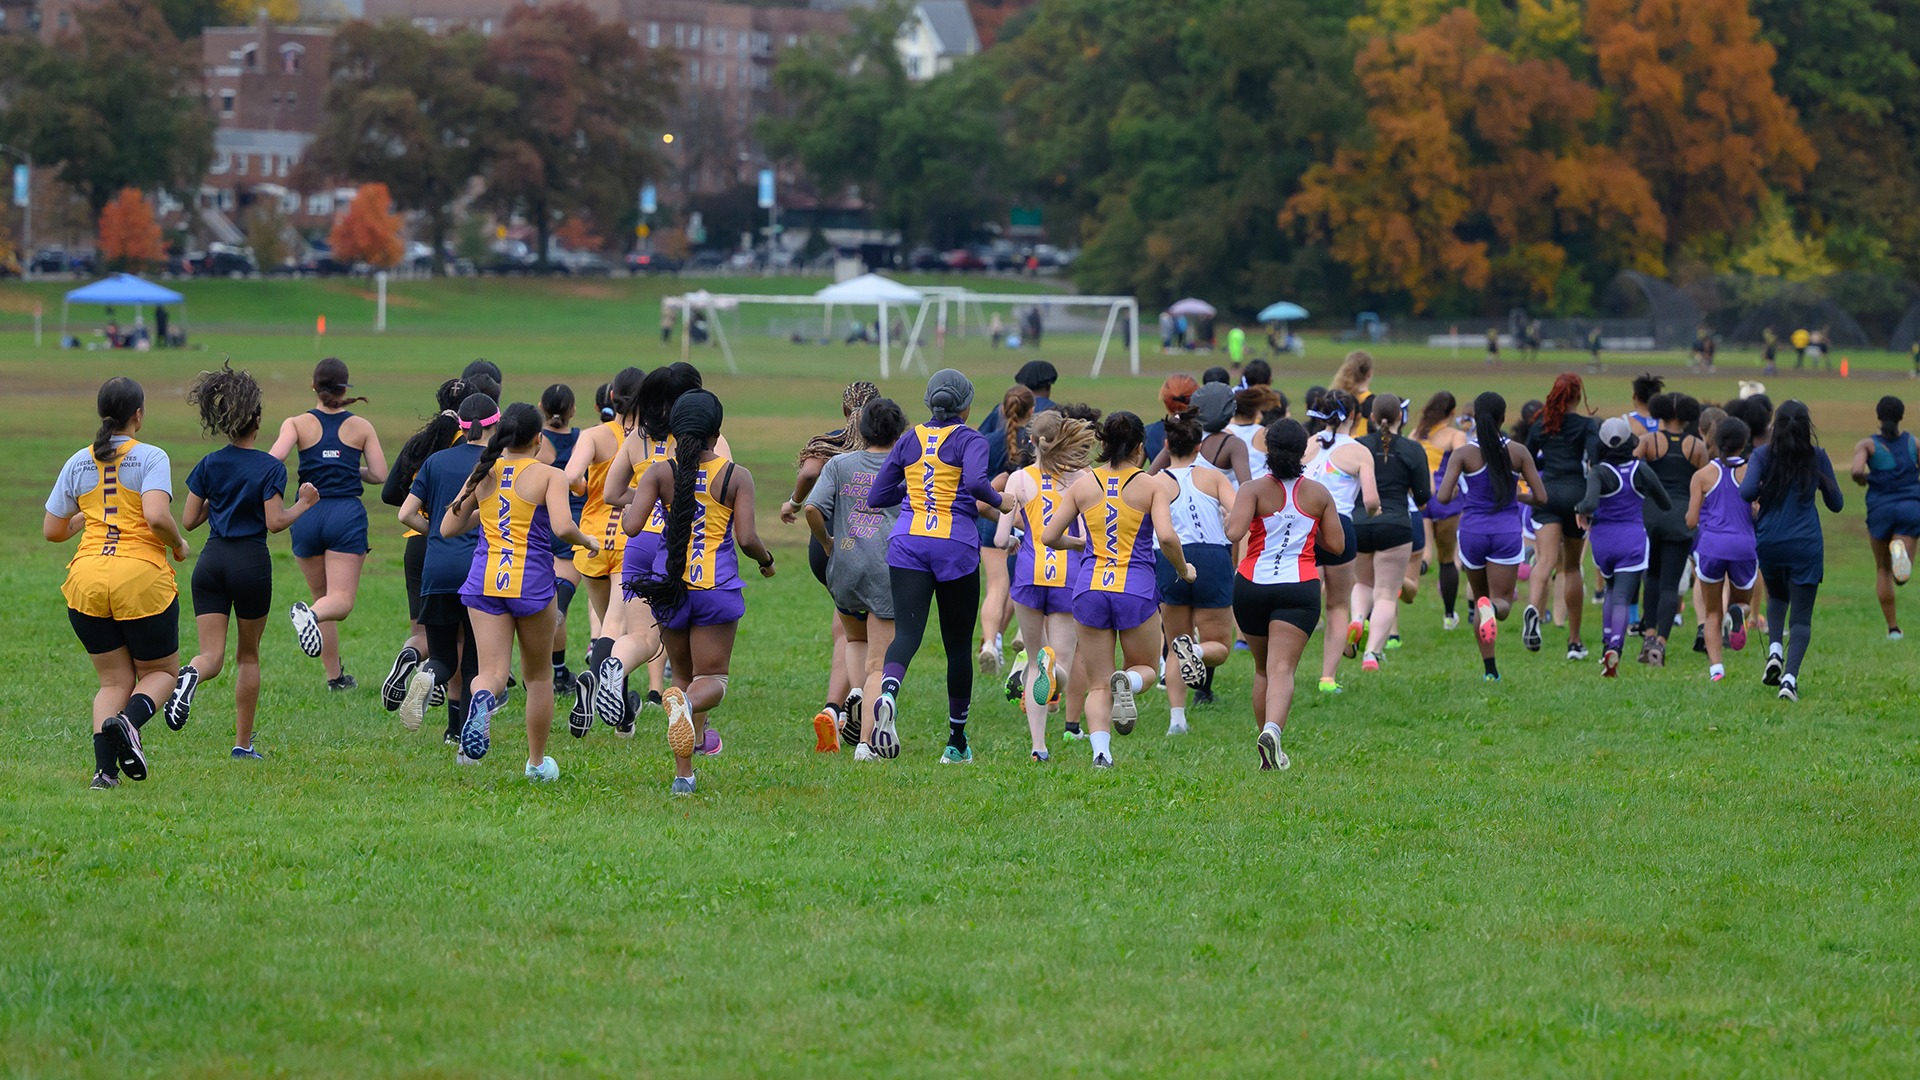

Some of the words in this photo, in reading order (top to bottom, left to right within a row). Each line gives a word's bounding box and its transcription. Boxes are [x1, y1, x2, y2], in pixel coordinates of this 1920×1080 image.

[840, 484, 872, 498] ARO
[851, 471, 877, 485] HA
[923, 433, 939, 532] HAWKS
[495, 465, 515, 592] HAWKS
[689, 469, 708, 585] HAWKS
[847, 512, 884, 525] FIND
[848, 526, 879, 538] OUT
[1102, 476, 1119, 588] HAWKS
[1189, 496, 1202, 529] JOHN
[1273, 522, 1293, 576] CARDINALS
